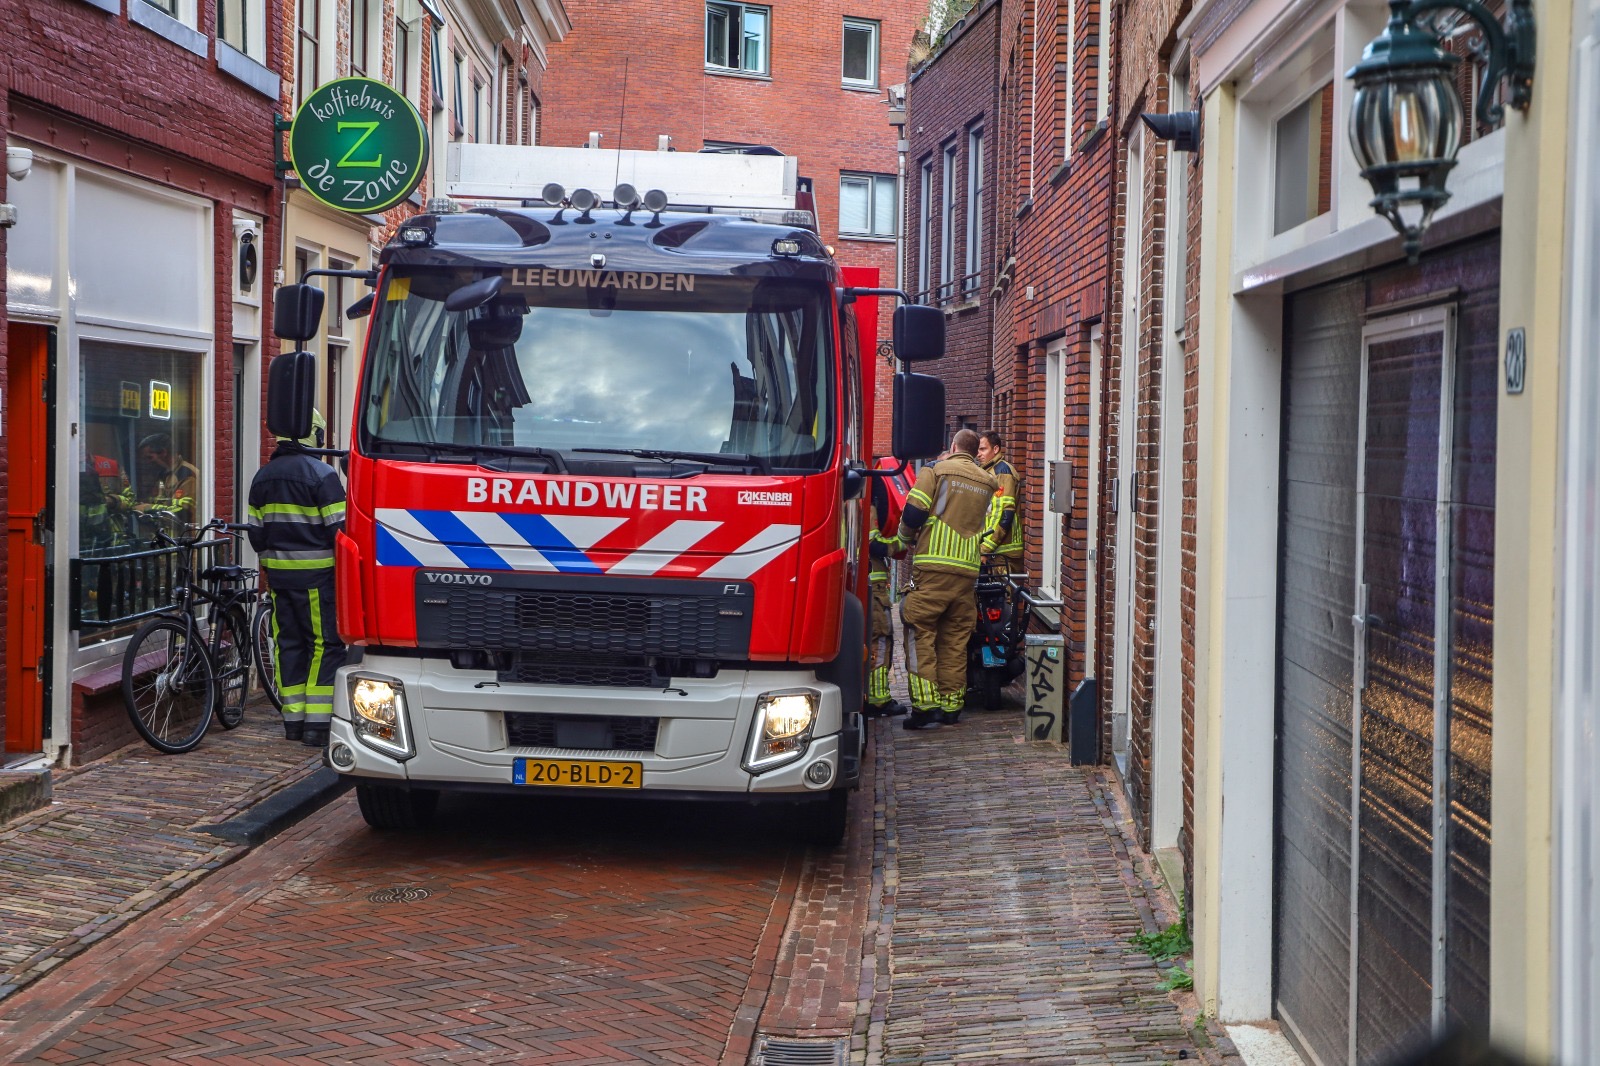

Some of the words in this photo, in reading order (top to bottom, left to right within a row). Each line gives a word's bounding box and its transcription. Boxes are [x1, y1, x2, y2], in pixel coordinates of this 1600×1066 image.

[310, 85, 395, 122] koffiehuis
[337, 121, 382, 167] Z
[307, 158, 335, 192] de
[511, 268, 695, 292] LEEUWARDEN
[1507, 333, 1522, 388] 28
[153, 389, 169, 410] OPEN
[467, 478, 707, 512] BRANDWEER
[752, 491, 792, 502] KENBRI
[424, 572, 493, 585] VOLVO
[723, 585, 746, 595] FL
[532, 763, 634, 785] 20-BLD-2
